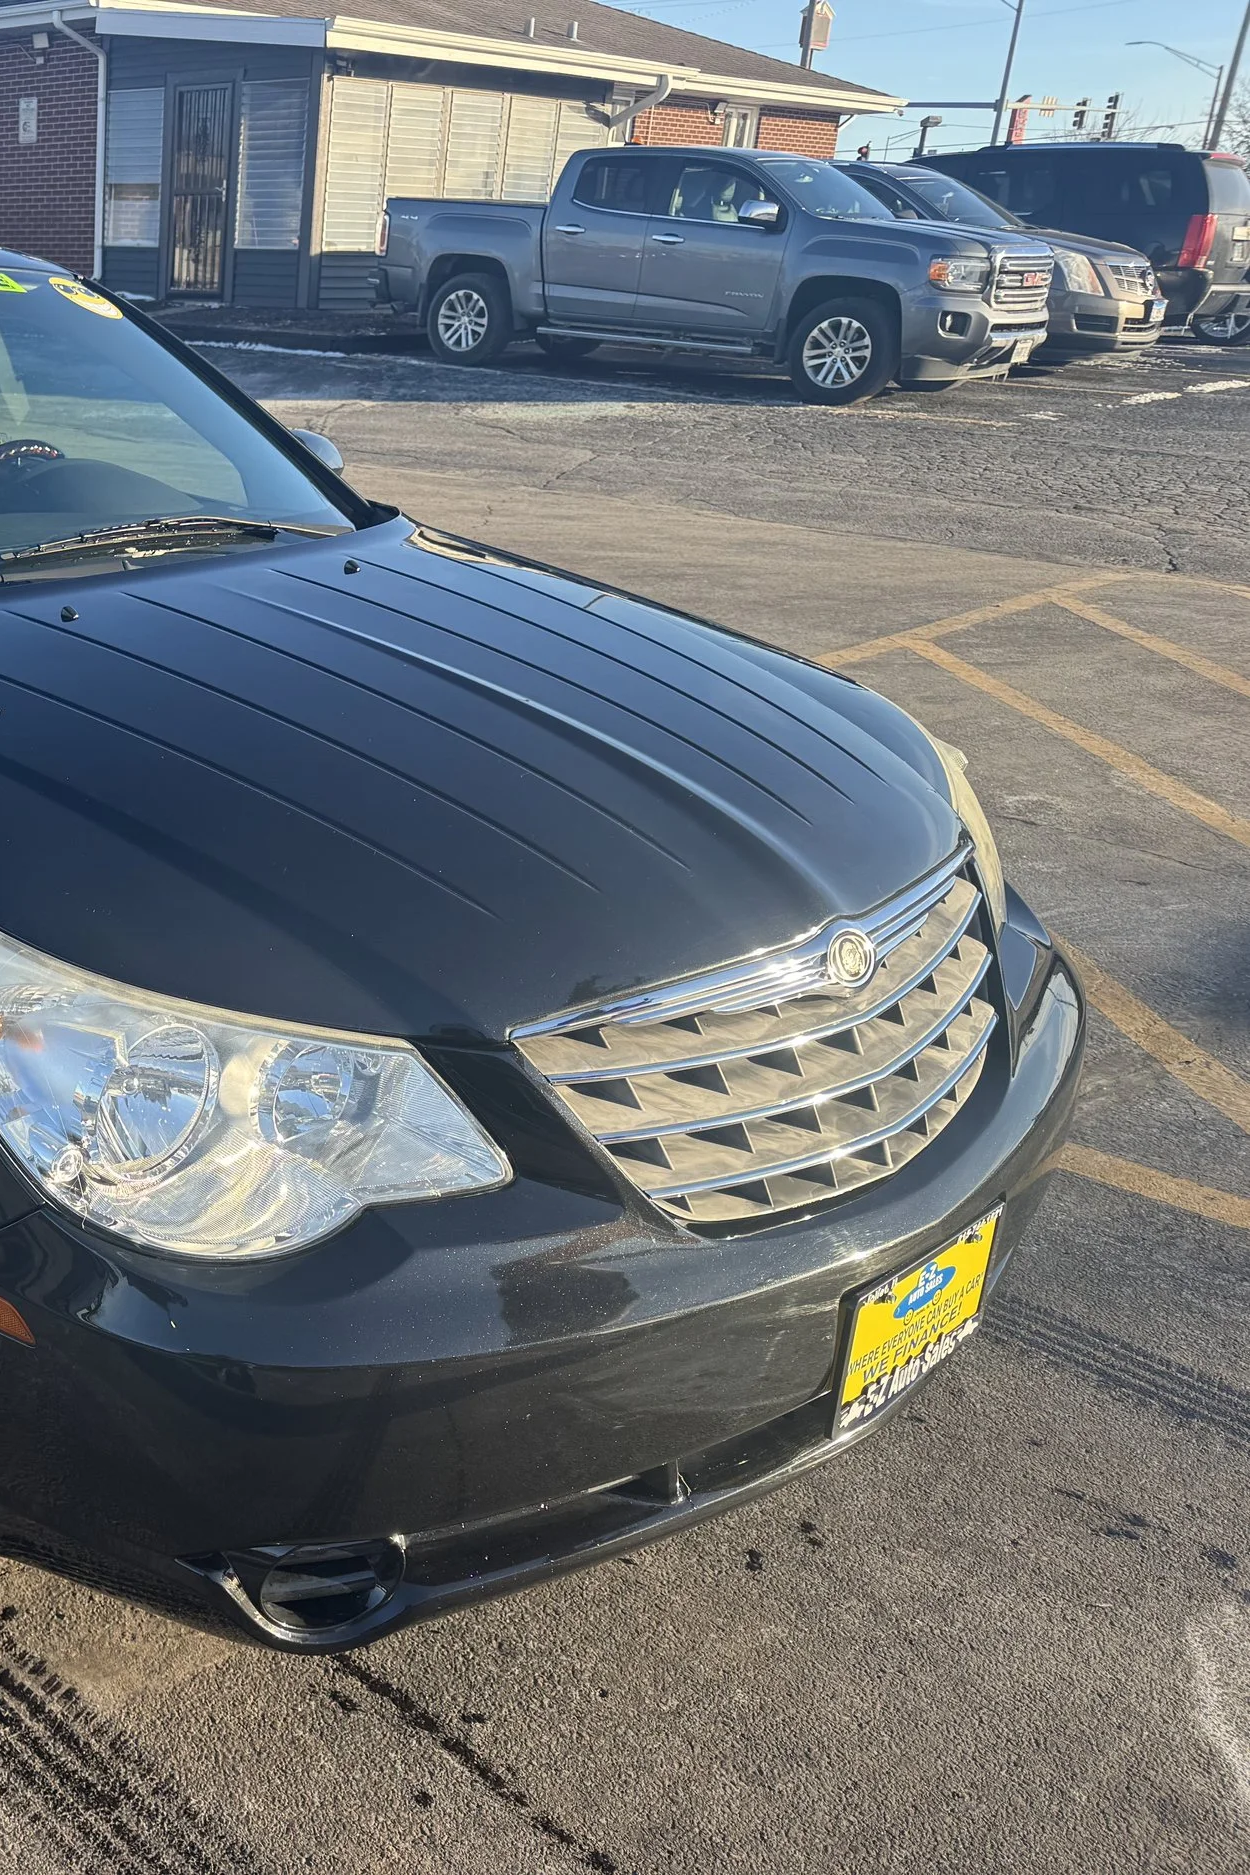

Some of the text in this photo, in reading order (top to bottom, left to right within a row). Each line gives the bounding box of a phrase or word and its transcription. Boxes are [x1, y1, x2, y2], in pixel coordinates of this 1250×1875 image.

[908, 1273, 943, 1305] AUTO SALES
[863, 1301, 962, 1382] WE FINANCE!
[881, 1315, 925, 1356] EVERYONE
[926, 1304, 941, 1325] CAN
[943, 1294, 958, 1313] BUY
[958, 1289, 964, 1301] A
[888, 1355, 920, 1399] Auto
[921, 1333, 956, 1373] Sales
